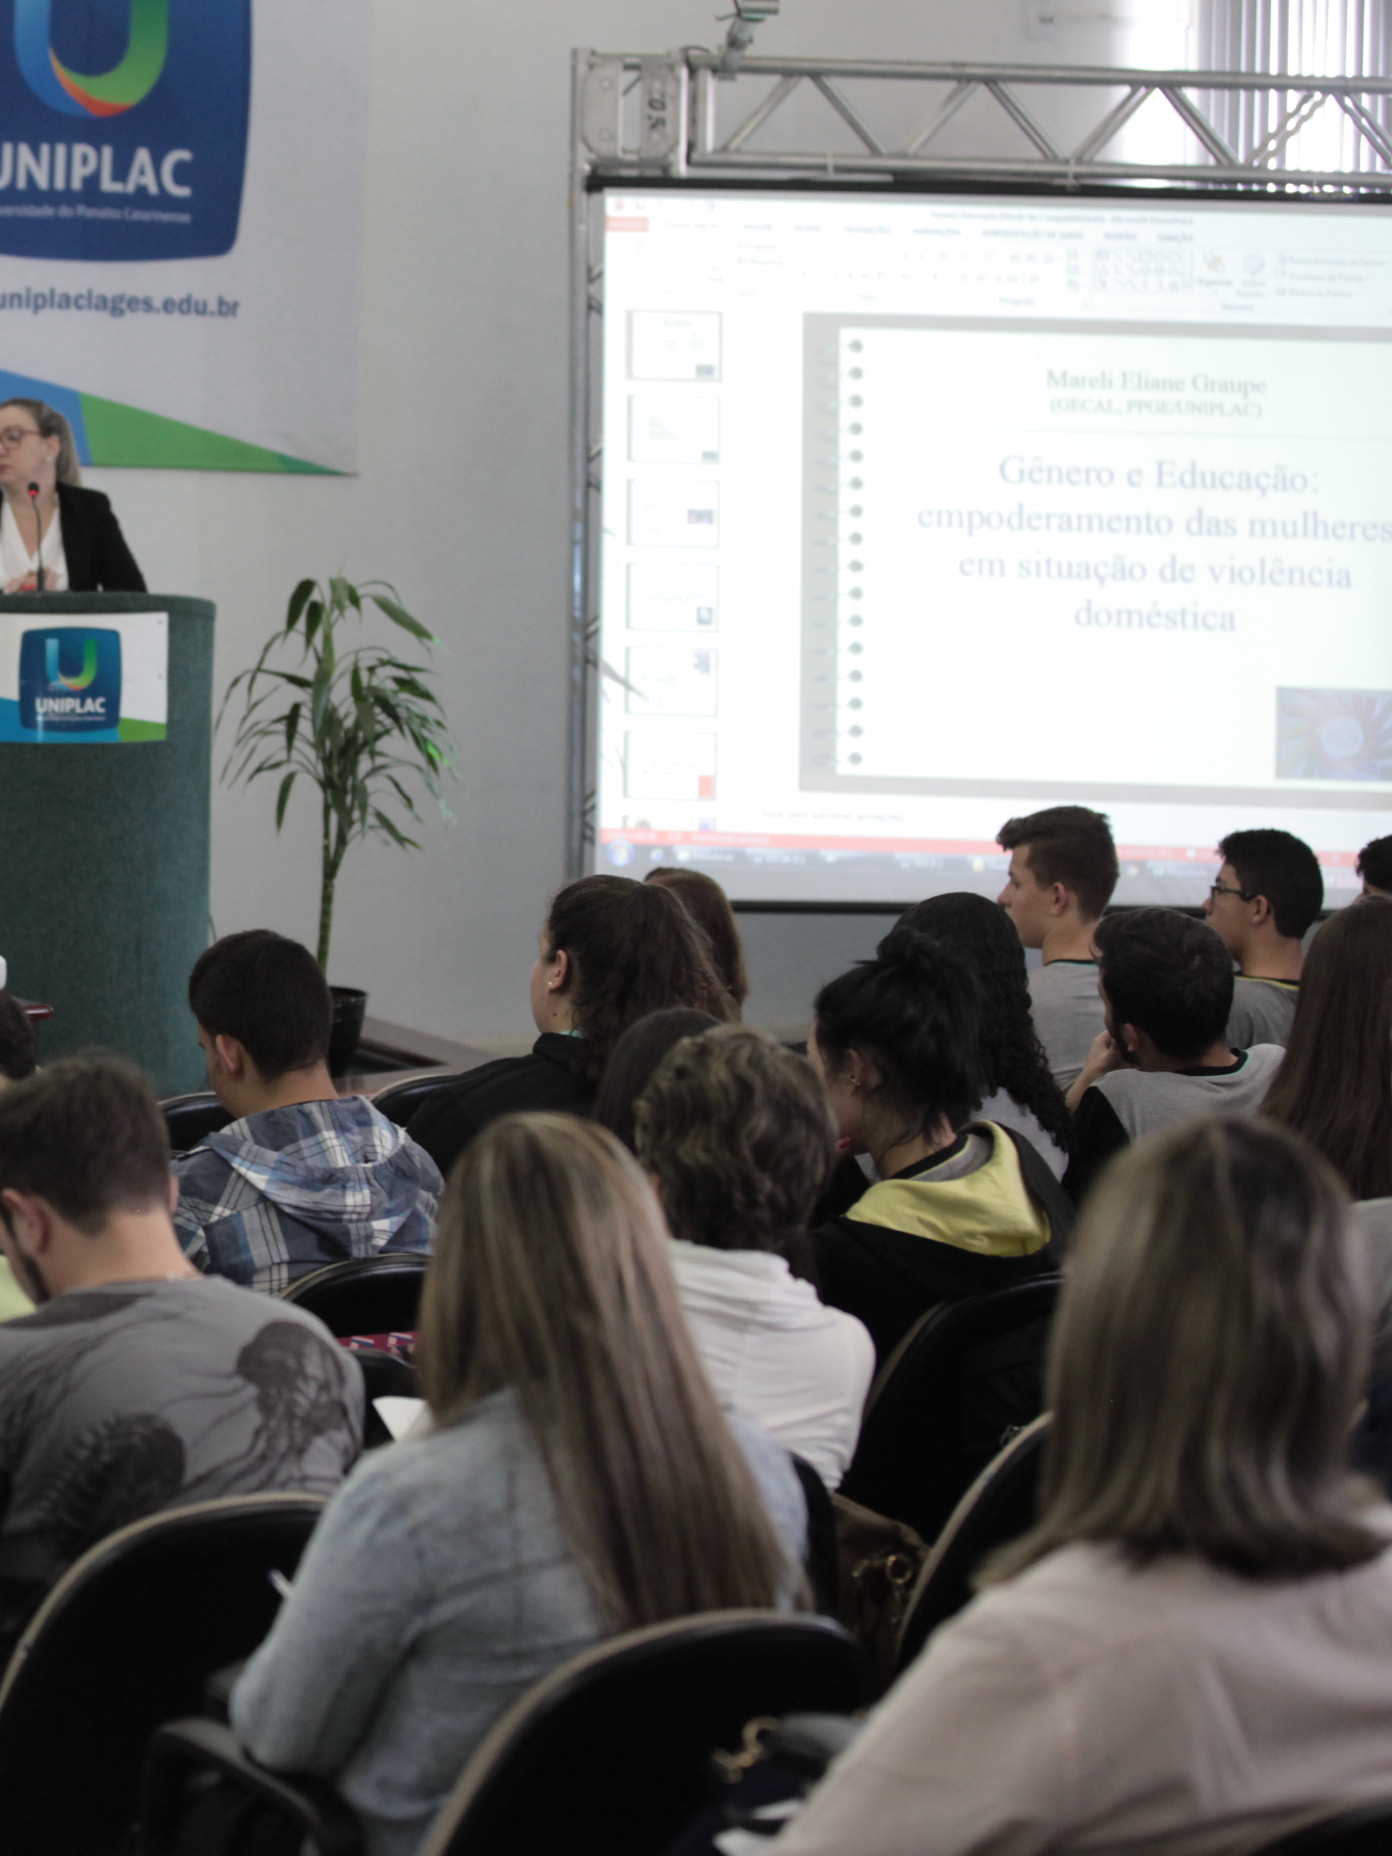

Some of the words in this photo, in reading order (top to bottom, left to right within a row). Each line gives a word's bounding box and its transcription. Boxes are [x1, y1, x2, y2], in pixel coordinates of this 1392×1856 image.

[1045, 369, 1113, 391] Mareli
[1120, 370, 1185, 392] Eliane
[1191, 373, 1267, 400] Graupe
[998, 454, 1115, 488] Gênero
[1126, 469, 1143, 488] e
[1154, 459, 1319, 498] Educação:
[917, 502, 1174, 537] empoderamento
[1184, 506, 1237, 538] das
[1247, 509, 1392, 542] mulheres
[959, 556, 1006, 578] em
[1018, 549, 1147, 587] situação
[1158, 554, 1196, 584] de
[1208, 554, 1352, 589] violência
[1074, 598, 1237, 631] doméstica
[35, 697, 106, 713] UNIPLAC
